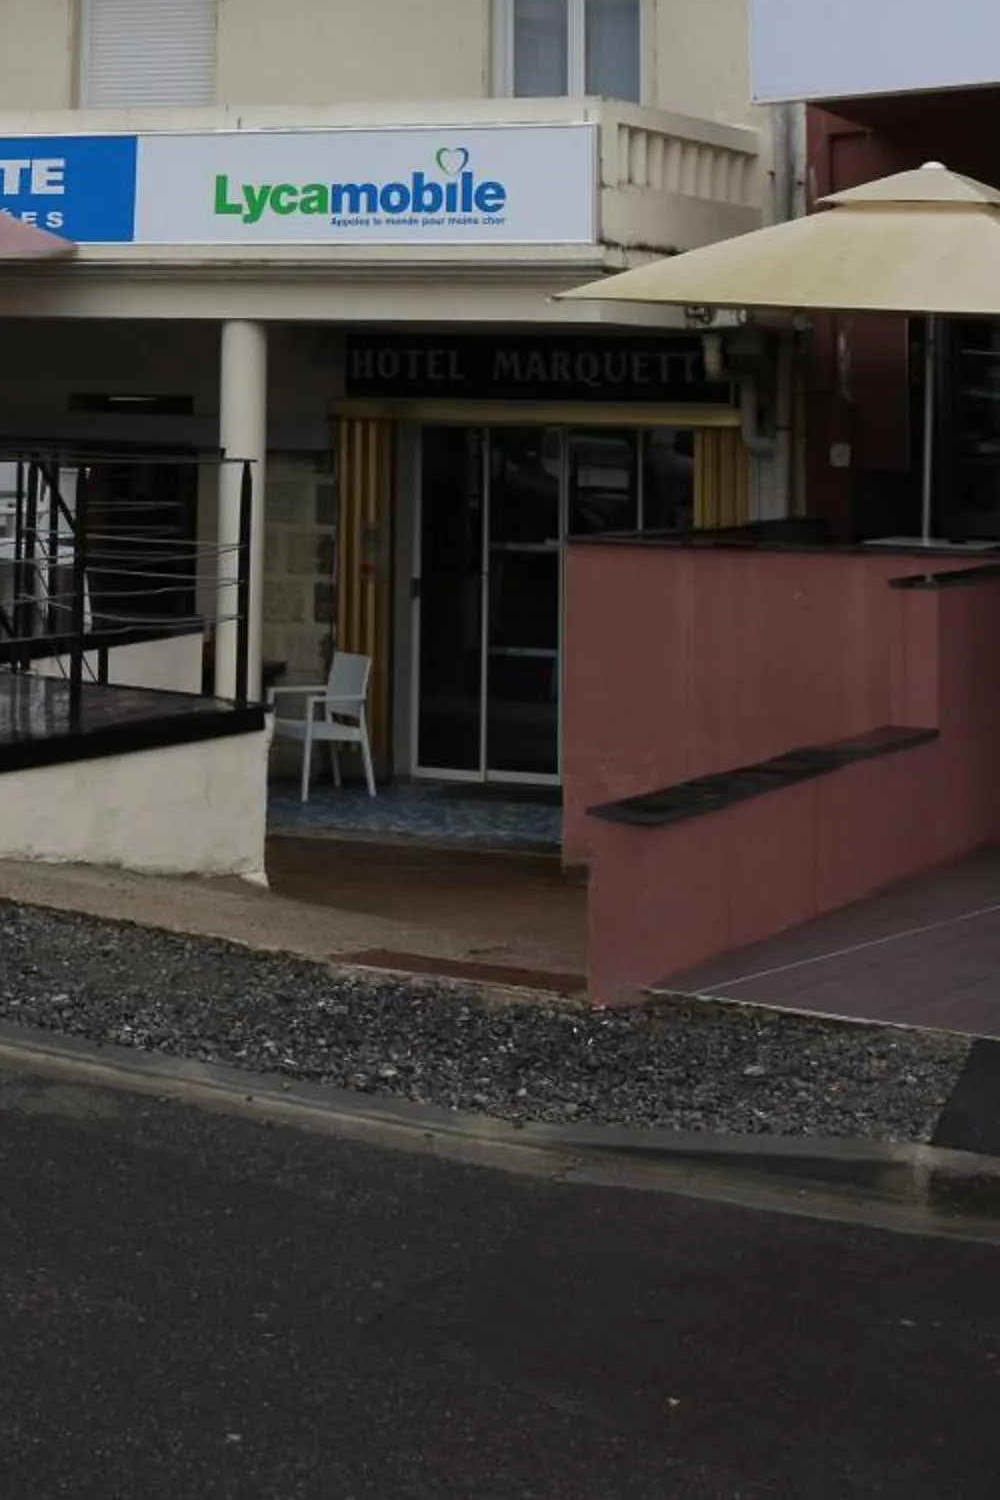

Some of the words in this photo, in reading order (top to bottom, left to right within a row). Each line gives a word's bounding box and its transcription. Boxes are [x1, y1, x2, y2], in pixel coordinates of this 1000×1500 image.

[214, 171, 507, 224] Lycamobile
[386, 216, 419, 226] monde
[422, 218, 445, 227] pour
[448, 216, 479, 226] moins
[482, 216, 505, 226] cher
[351, 348, 465, 380] HOTEL
[493, 349, 713, 387] MARQUETT
